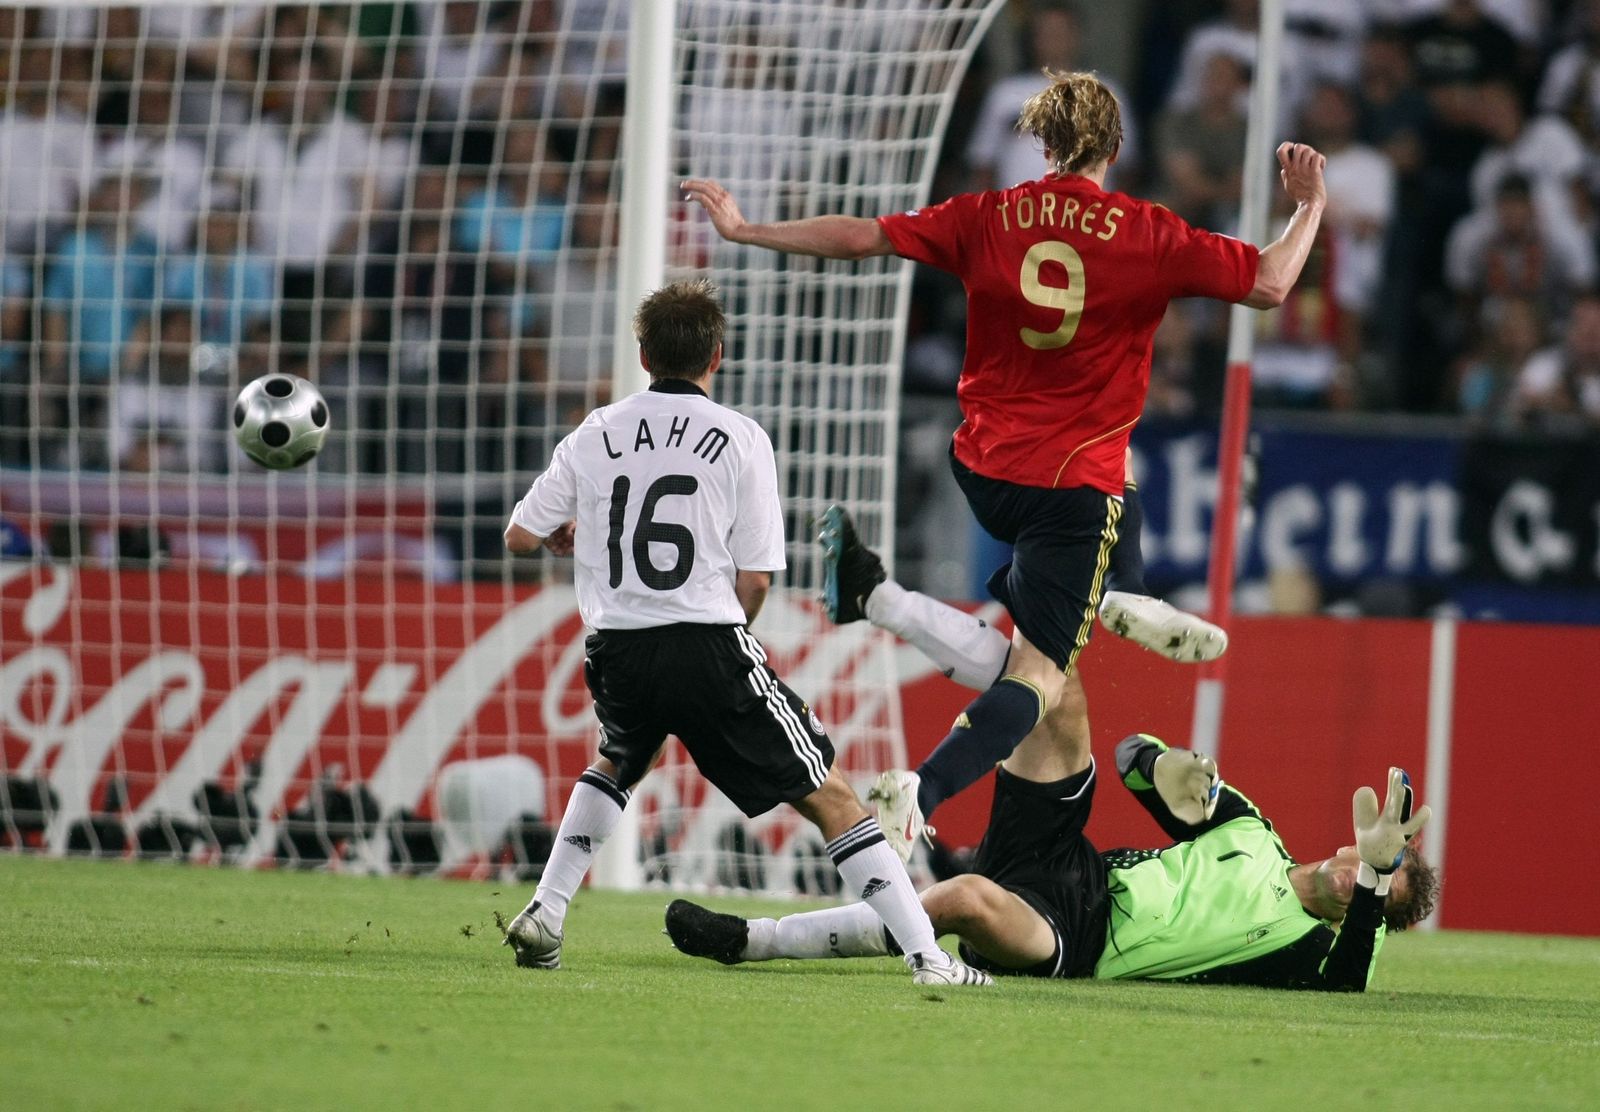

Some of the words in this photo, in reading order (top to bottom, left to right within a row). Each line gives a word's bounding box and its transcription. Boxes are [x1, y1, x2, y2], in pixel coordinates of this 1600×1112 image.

[996, 192, 1124, 241] TORRES
[1019, 240, 1086, 350] 9
[602, 415, 730, 465] LAHM
[606, 474, 699, 591] 16
